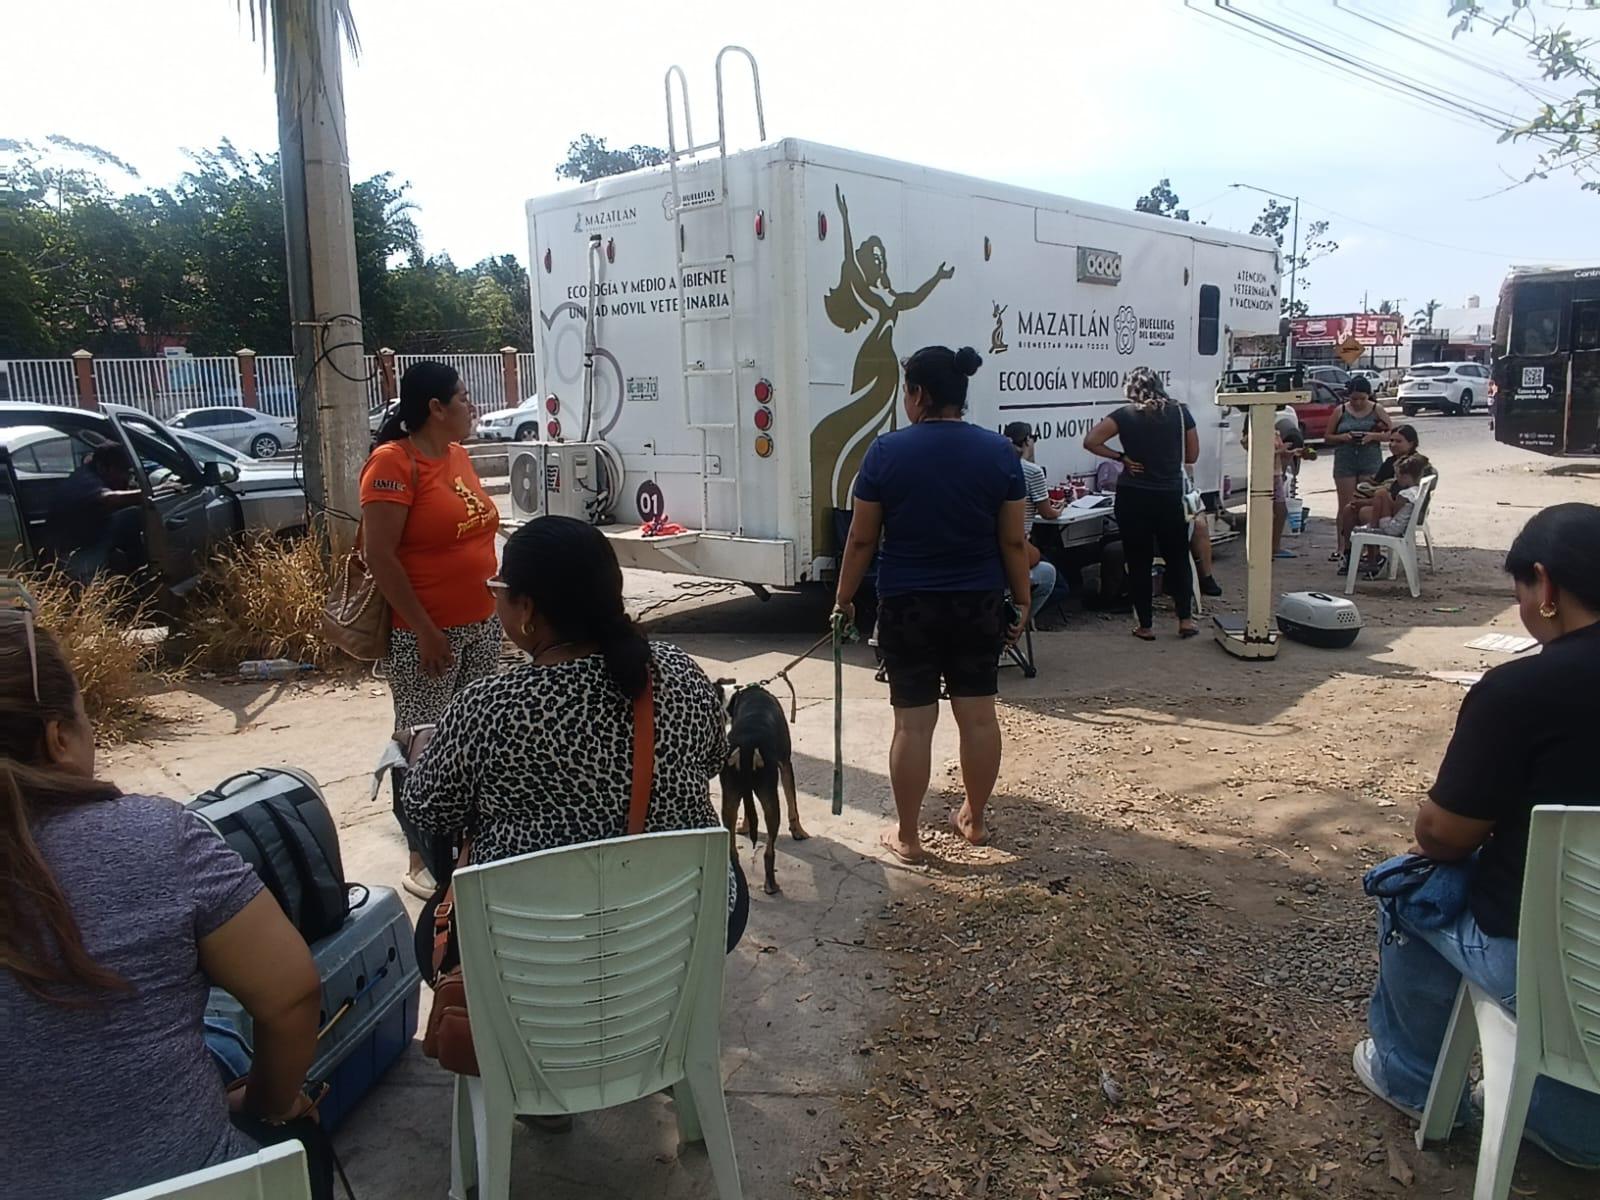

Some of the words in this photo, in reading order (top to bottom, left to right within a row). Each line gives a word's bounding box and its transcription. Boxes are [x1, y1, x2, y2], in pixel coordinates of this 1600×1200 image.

[567, 280, 618, 299] ECOOGÍA
[621, 281, 629, 294] Y
[631, 277, 666, 293] MEDIO
[569, 304, 608, 320] UNIAD
[611, 300, 647, 316] MOVIL
[650, 293, 729, 313] VETEINARIA
[1018, 309, 1110, 337] MAZATLÁN
[1139, 318, 1175, 330] HUELLITAS
[1018, 341, 1061, 349] BIENESTAR
[999, 366, 1067, 391] ECOLOGÍA
[1072, 371, 1080, 390] Y
[1083, 370, 1119, 389] MEDIO
[640, 492, 658, 515] 01
